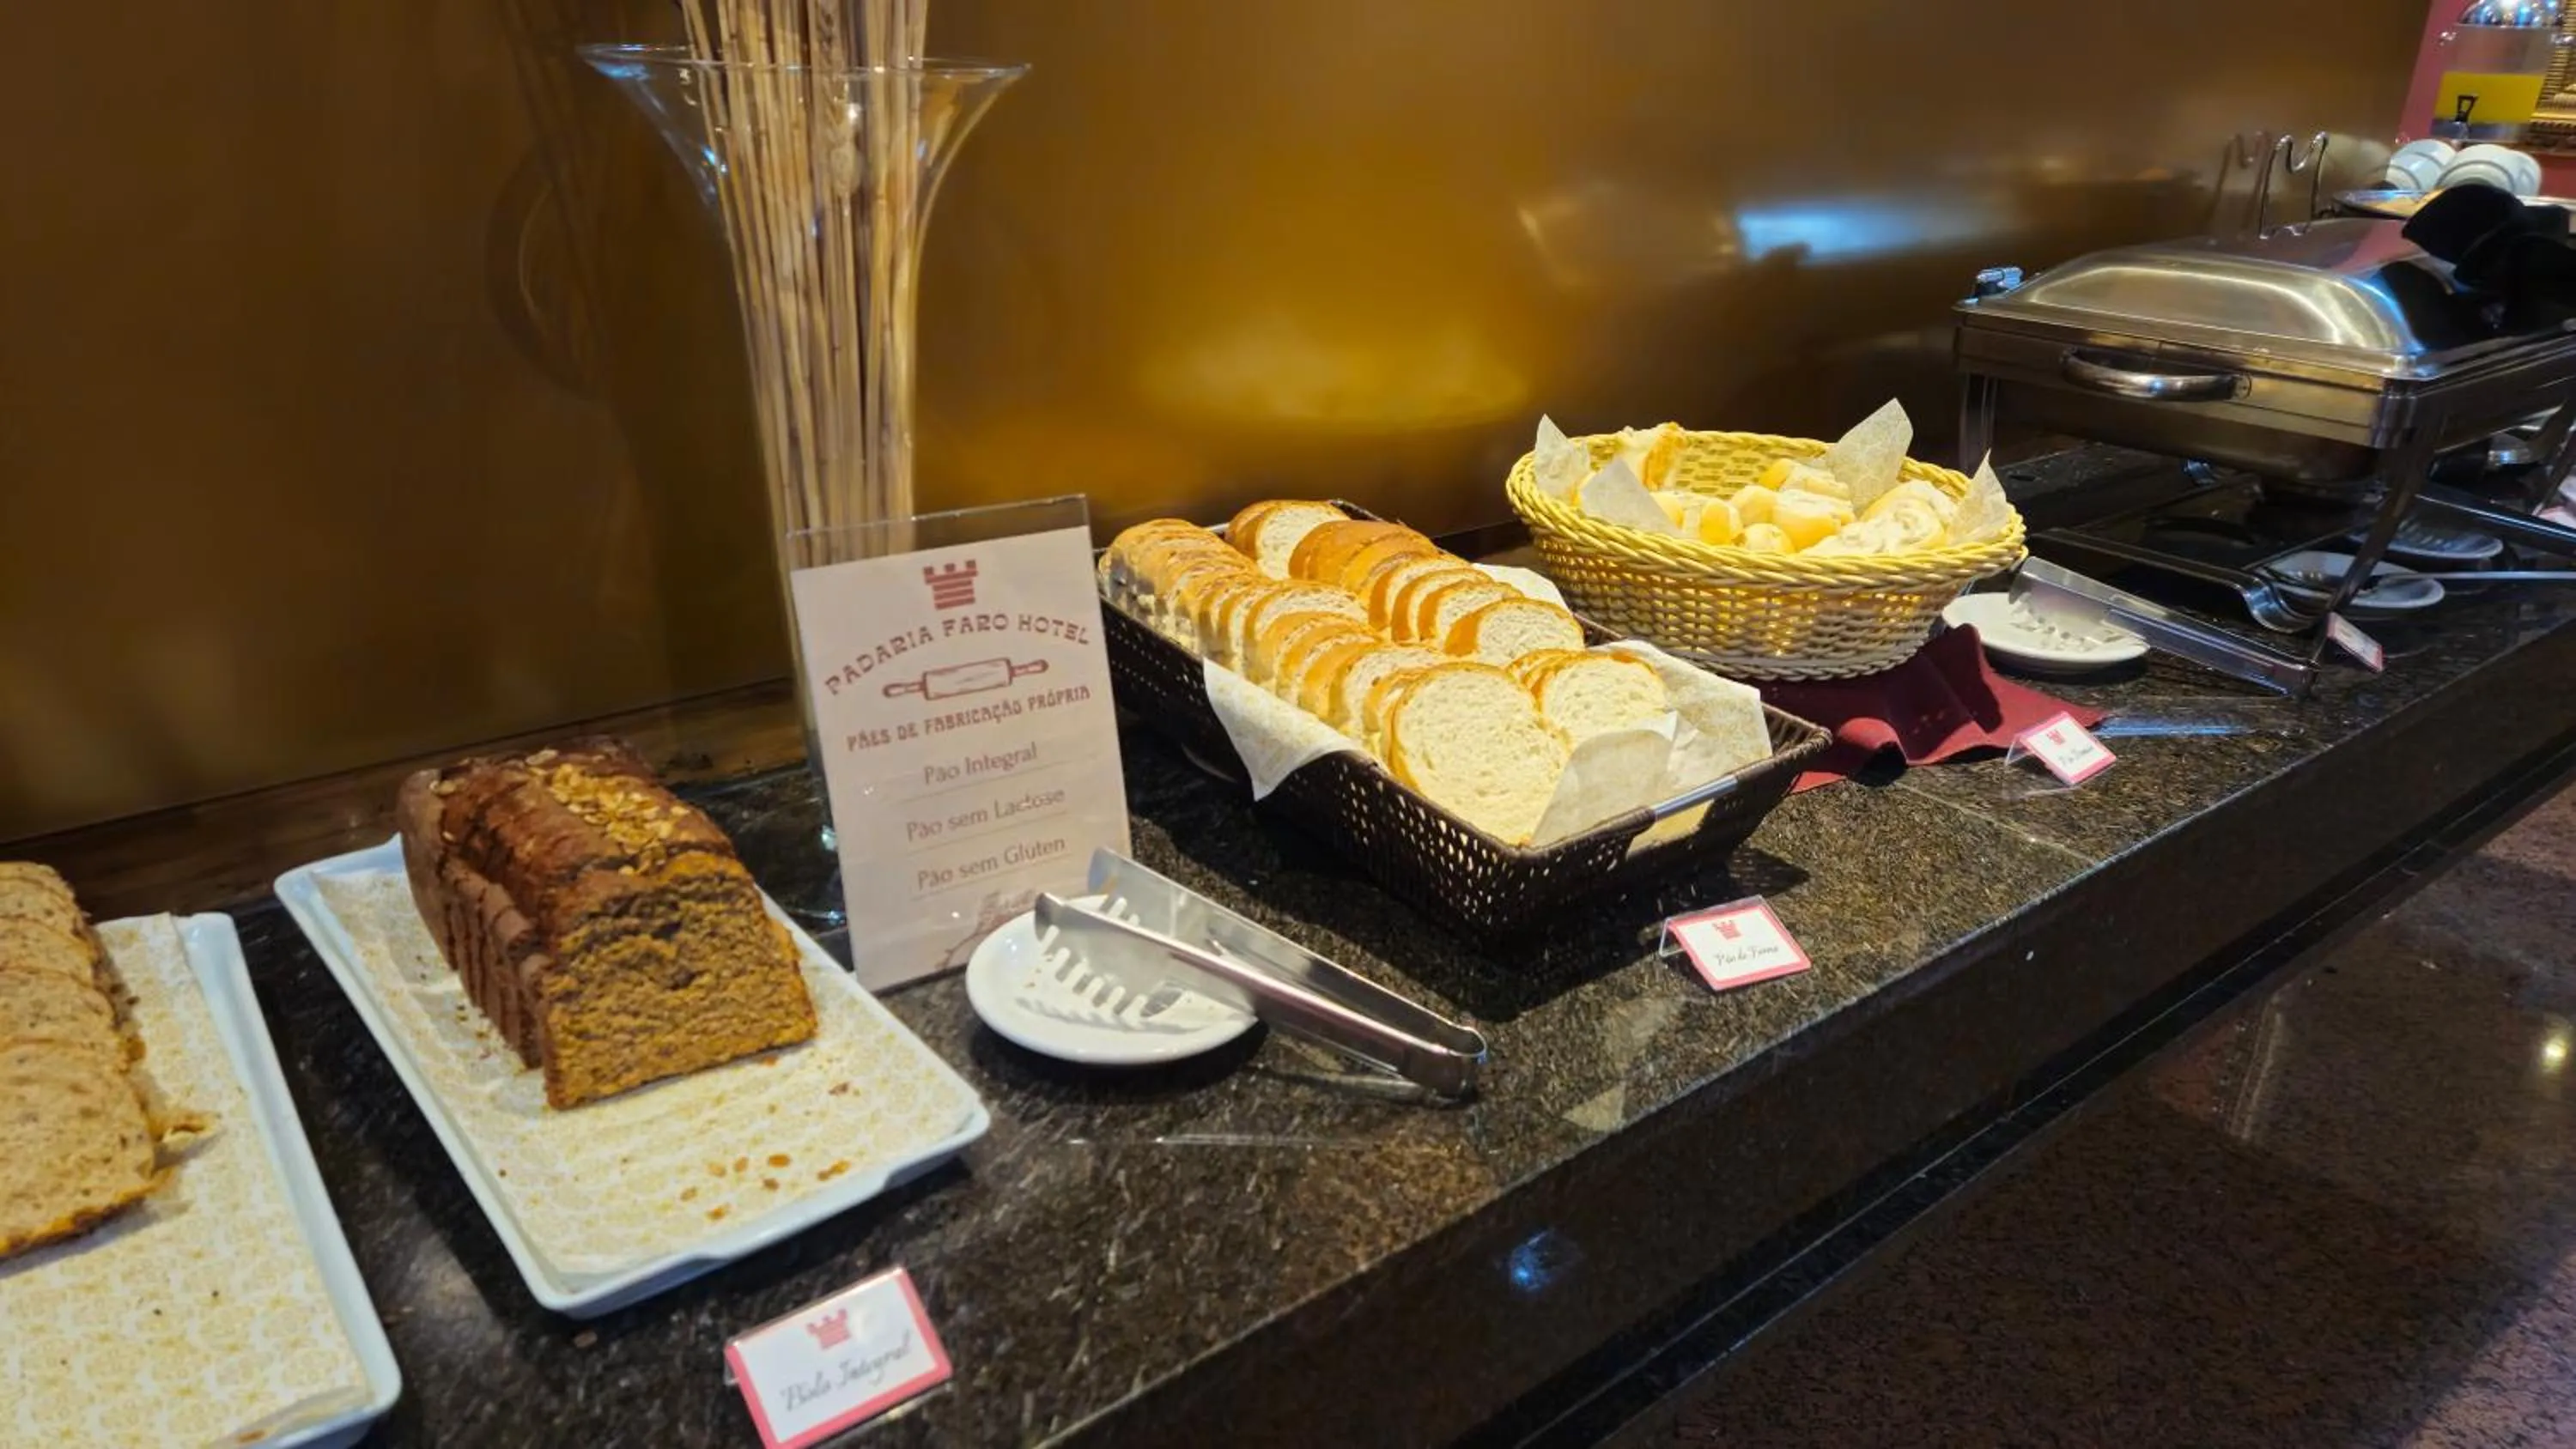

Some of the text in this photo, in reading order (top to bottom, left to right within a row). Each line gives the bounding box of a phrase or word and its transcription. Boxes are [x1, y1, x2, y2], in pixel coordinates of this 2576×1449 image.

[824, 614, 1089, 695] PADARIA FARO HOTEL
[897, 723, 920, 742] DE
[925, 698, 1023, 736] FABRICAÇÃO
[1029, 684, 1091, 712] PRÓPRIA
[964, 741, 1037, 776] Integral
[947, 809, 988, 831] sem
[993, 789, 1066, 819] Lactose
[958, 856, 999, 878] sem
[1004, 837, 1066, 865] Gluten
